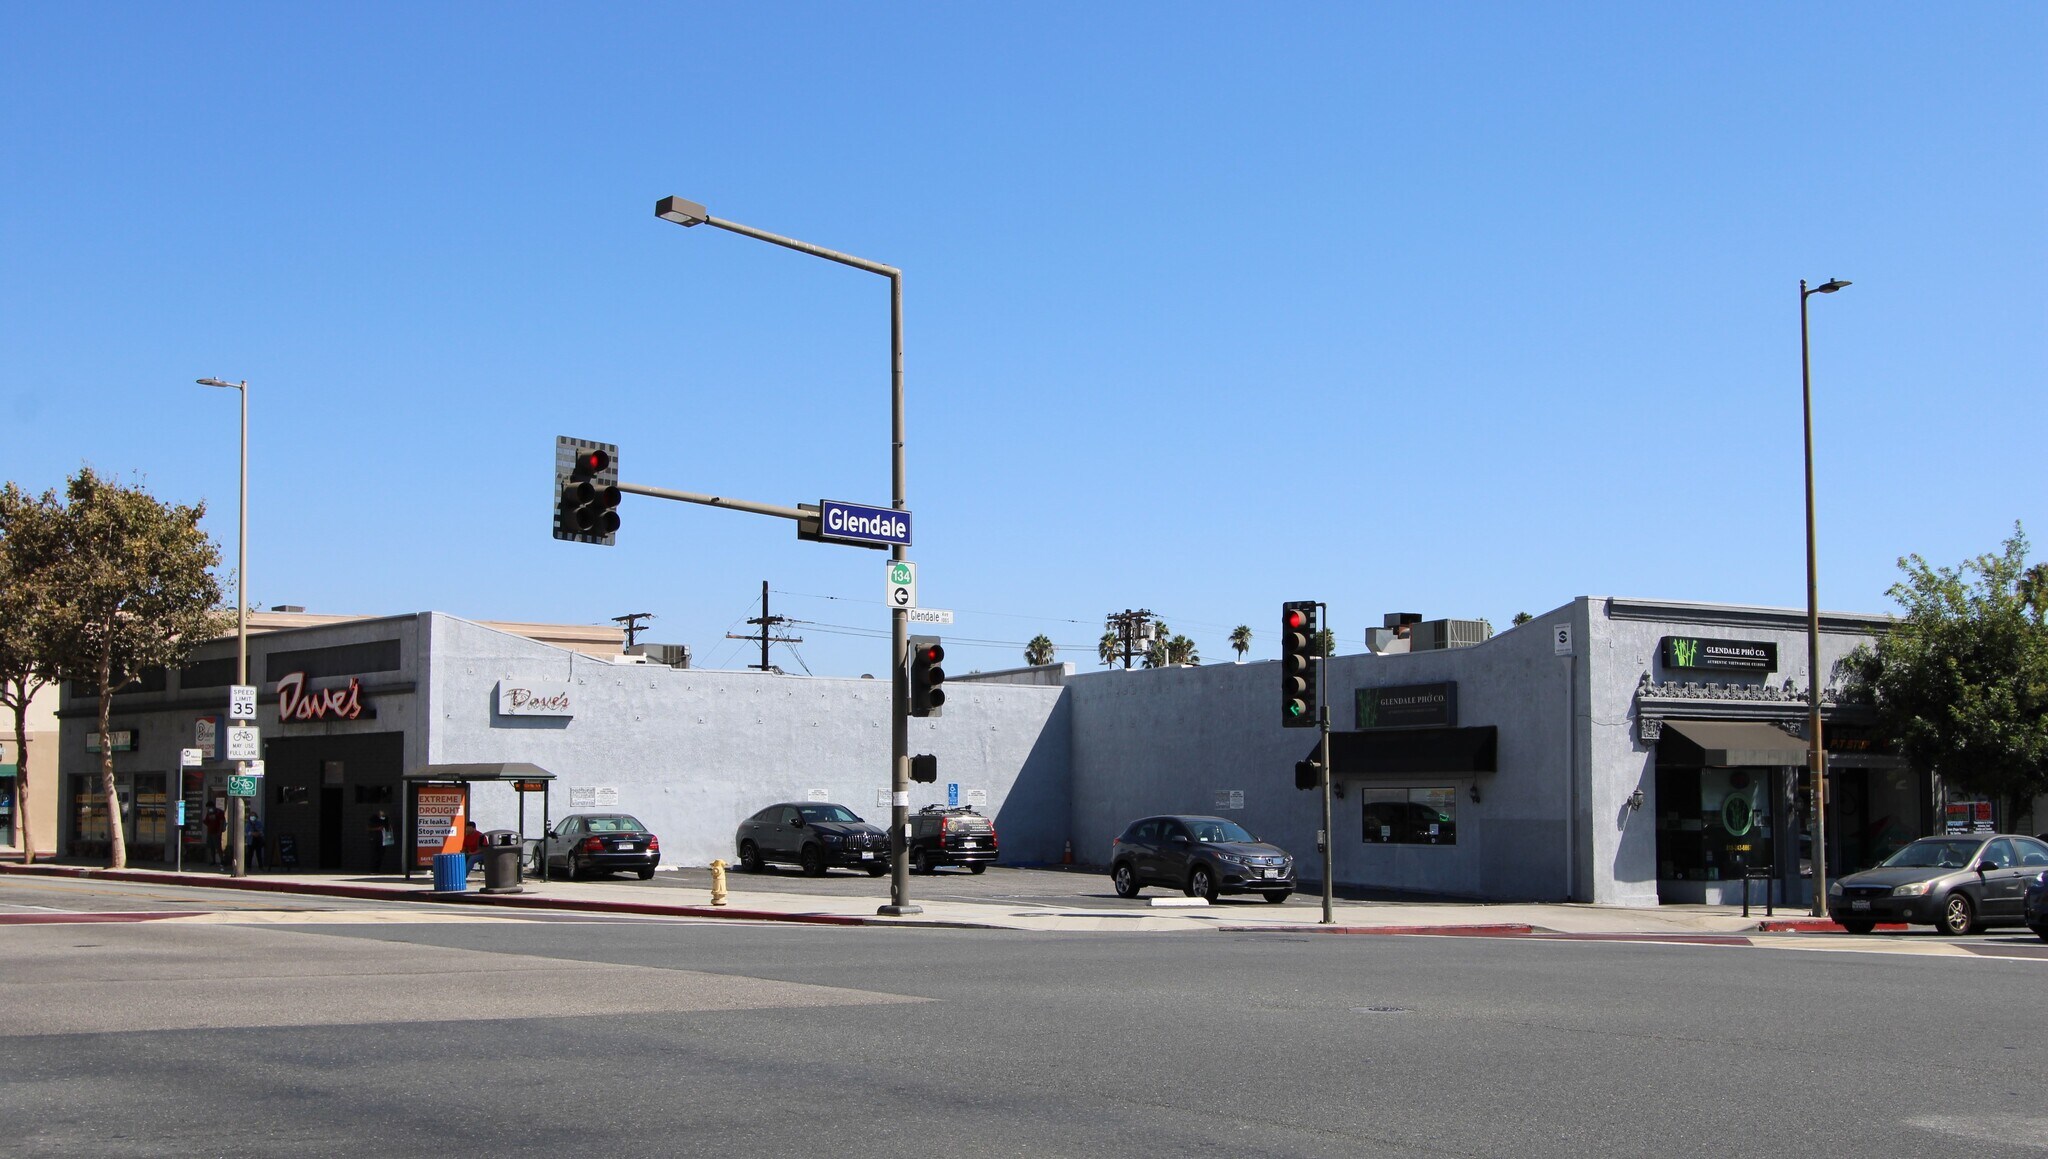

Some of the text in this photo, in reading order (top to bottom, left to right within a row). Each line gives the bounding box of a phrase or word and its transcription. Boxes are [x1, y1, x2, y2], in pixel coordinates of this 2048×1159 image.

[829, 508, 906, 538] Glendale
[893, 570, 910, 582] 134
[911, 610, 939, 622] Glendale
[1706, 646, 1740, 655] GLENDALE
[277, 671, 361, 720] Dave's
[503, 688, 571, 713] Dave's
[1380, 696, 1417, 706] GLENDALE
[1433, 694, 1446, 703] CO.
[233, 702, 254, 715] 35
[419, 795, 458, 803] EXTREME
[419, 806, 460, 814] DROUGHT
[418, 828, 434, 836] Stop
